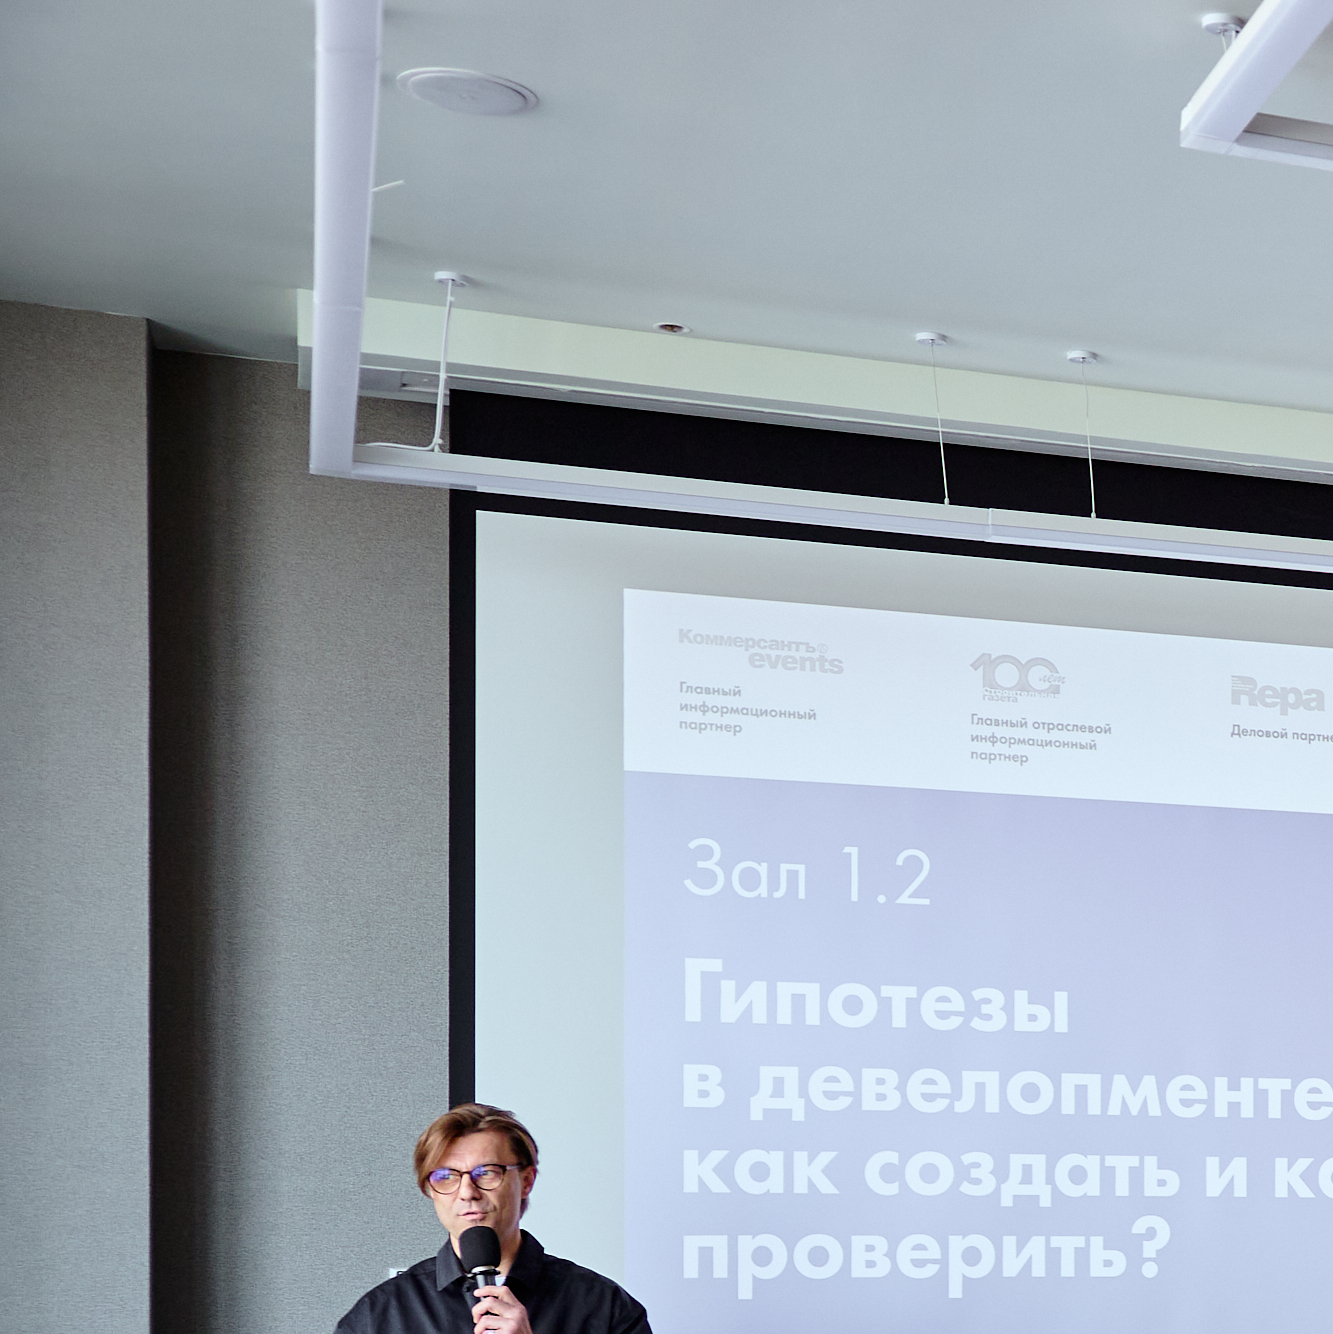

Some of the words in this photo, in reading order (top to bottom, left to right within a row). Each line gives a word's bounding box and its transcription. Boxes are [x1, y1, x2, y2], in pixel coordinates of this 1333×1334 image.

[678, 628, 816, 653] Коммерсантъ
[748, 650, 844, 675] events
[679, 681, 743, 698] Главный
[679, 702, 818, 721] информационный
[679, 719, 743, 736] партнер
[970, 713, 1028, 730] Главный
[1032, 718, 1112, 736] отраслевой
[1230, 724, 1289, 741] Деловой
[970, 732, 1098, 752] информационный
[970, 749, 1029, 767] партнер
[683, 837, 806, 900] Зал
[842, 845, 932, 905] 1.2
[683, 957, 1069, 1033] Гипотезы
[683, 1063, 725, 1108] в
[683, 1148, 839, 1194] как
[863, 1149, 1180, 1207] создать
[1205, 1156, 1248, 1198] и
[683, 1214, 1171, 1300] проверить?
